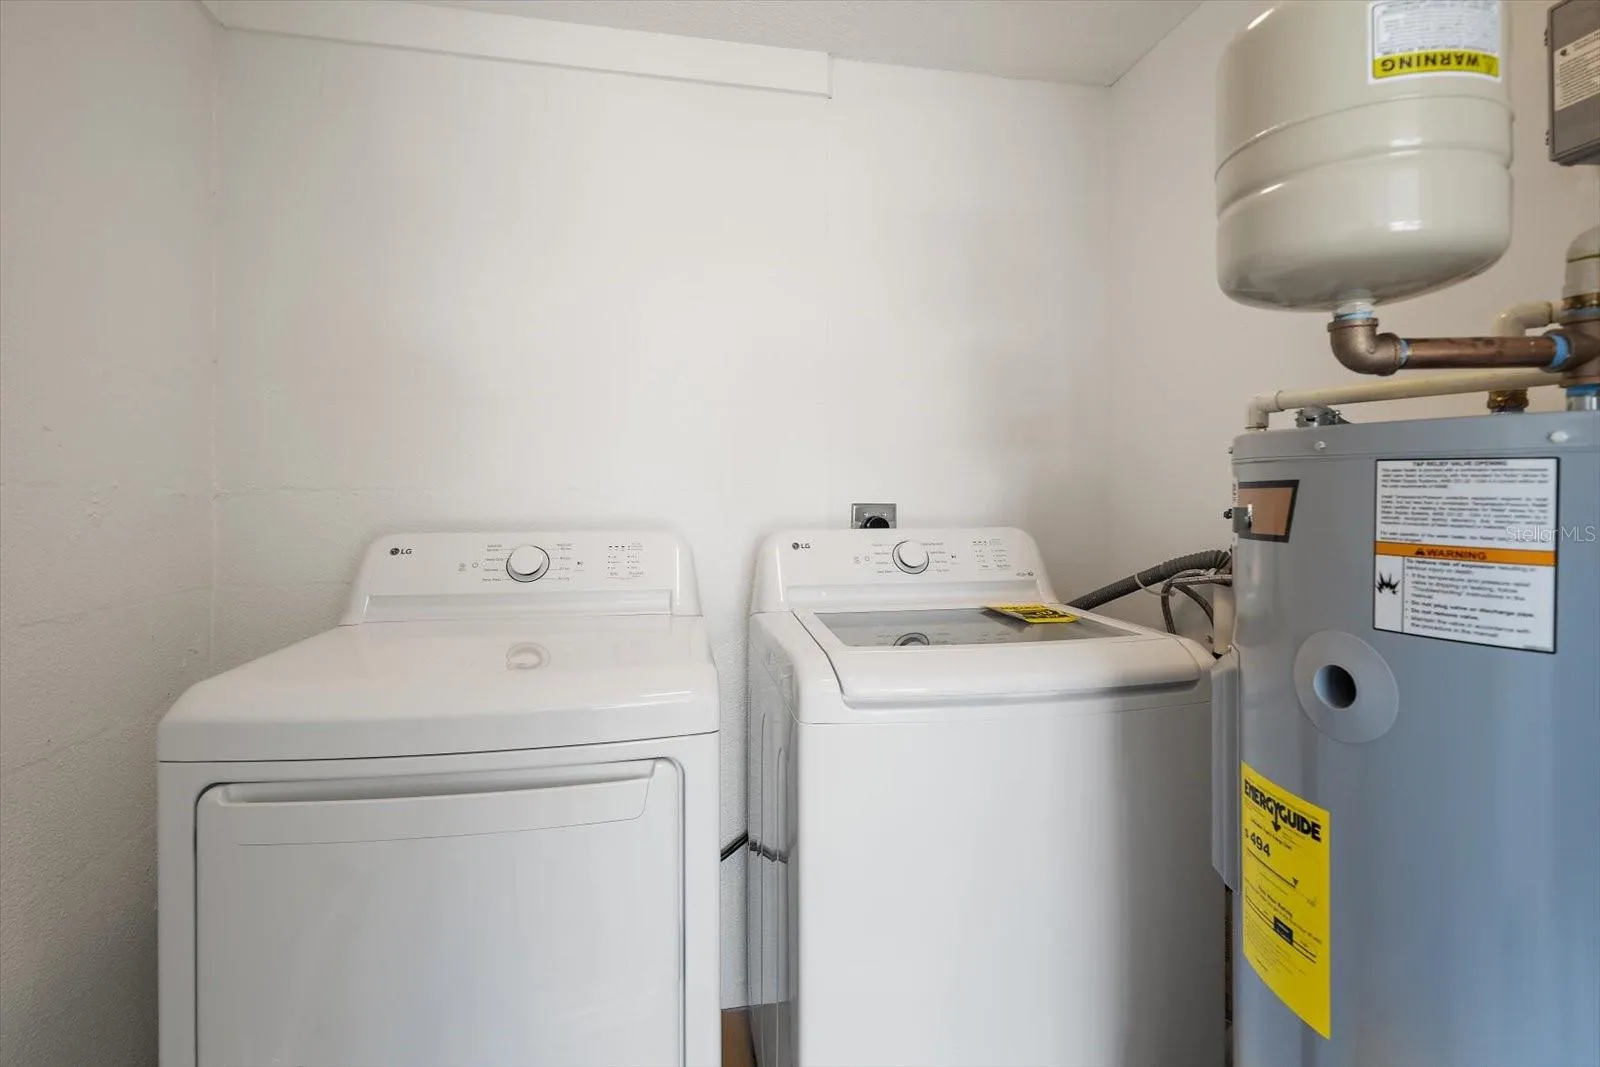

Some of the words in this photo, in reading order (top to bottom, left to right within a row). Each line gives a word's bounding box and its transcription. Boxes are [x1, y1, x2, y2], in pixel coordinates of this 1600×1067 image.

[1381, 53, 1480, 72] WARNING
[1426, 548, 1488, 561] WARNING
[1250, 832, 1271, 857] 494
